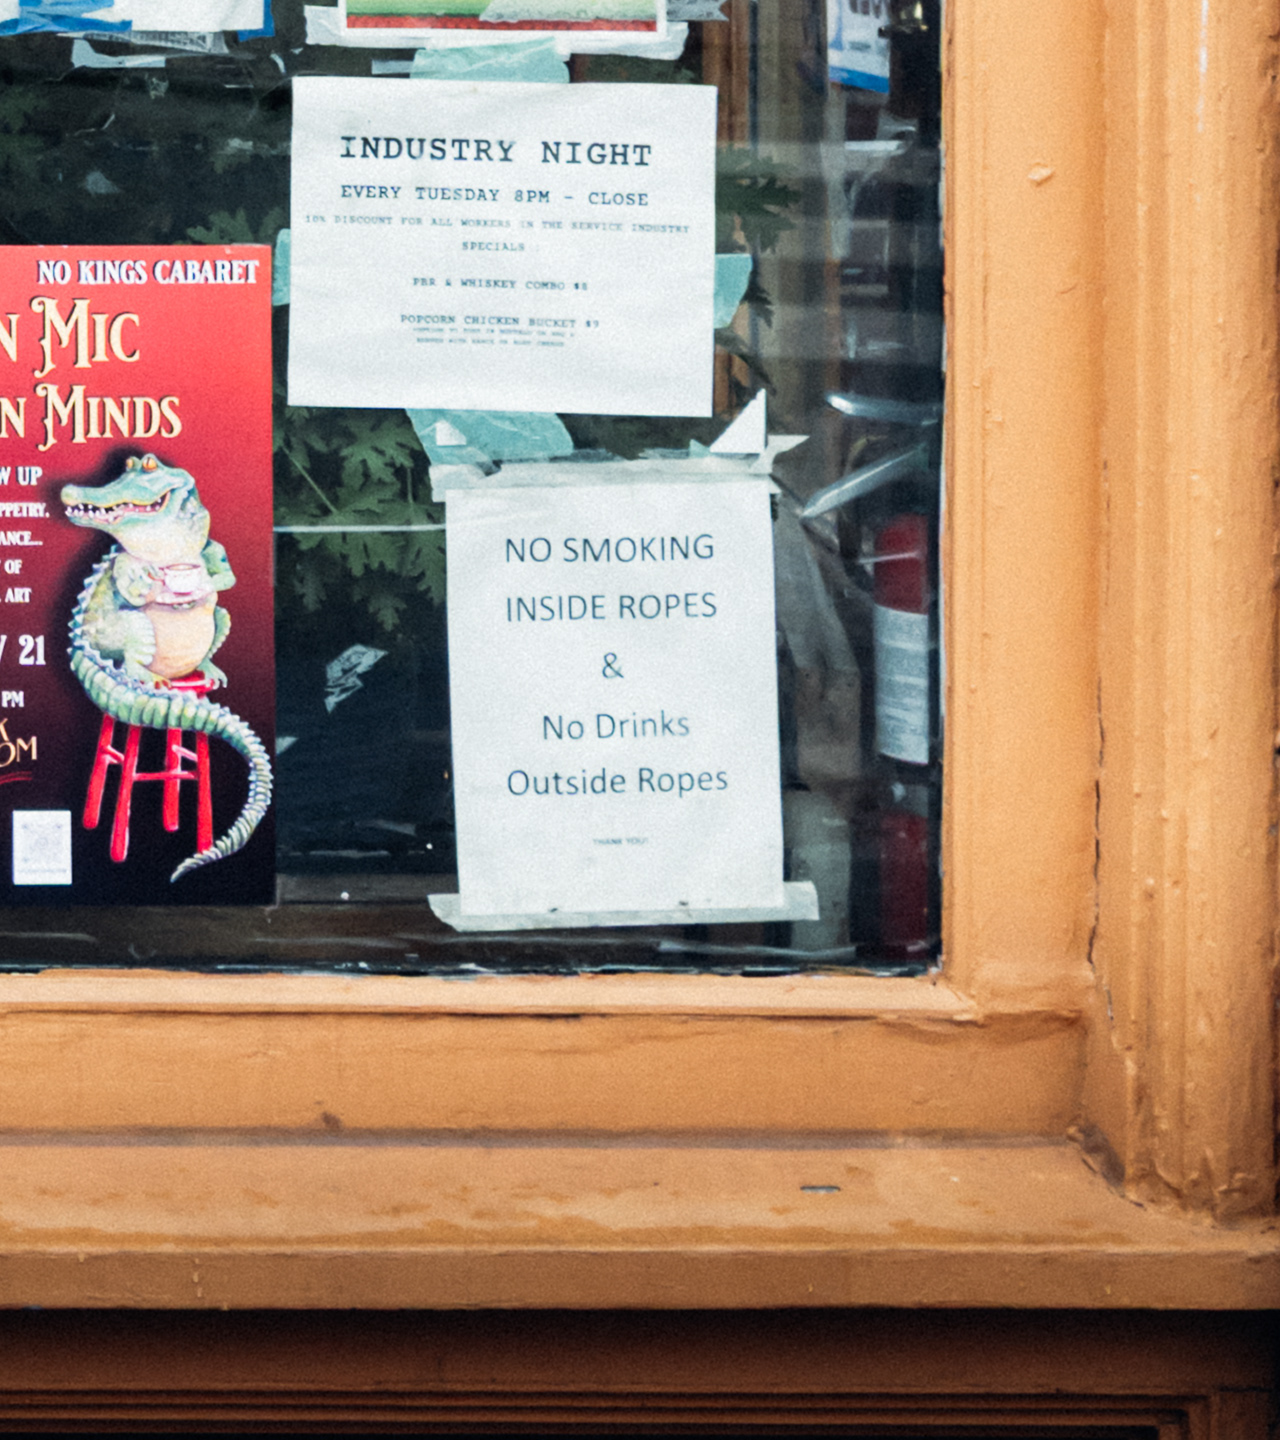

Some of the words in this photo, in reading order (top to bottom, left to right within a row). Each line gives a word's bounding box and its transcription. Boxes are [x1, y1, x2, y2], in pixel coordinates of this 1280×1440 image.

[340, 136, 515, 162] INDUSTRY
[542, 141, 651, 166] NIGHT
[341, 185, 401, 198] EVERY
[415, 187, 499, 201] TUESDAY
[515, 190, 549, 203] 8PM
[589, 192, 648, 206] CLOSE
[39, 260, 71, 284] NO
[79, 260, 147, 285] KINGS
[155, 260, 259, 284] CABARET
[32, 297, 139, 378] MIC
[36, 383, 181, 451] MINDS
[506, 538, 551, 562] NO
[564, 534, 713, 562] SMOKING
[507, 595, 605, 622] INSIDE
[620, 593, 716, 619] ROPES
[19, 635, 45, 665] 21
[602, 653, 624, 678] &
[543, 716, 584, 739] No
[596, 710, 689, 738] Drinks
[508, 768, 625, 795] Outside
[639, 768, 727, 797] Ropes
